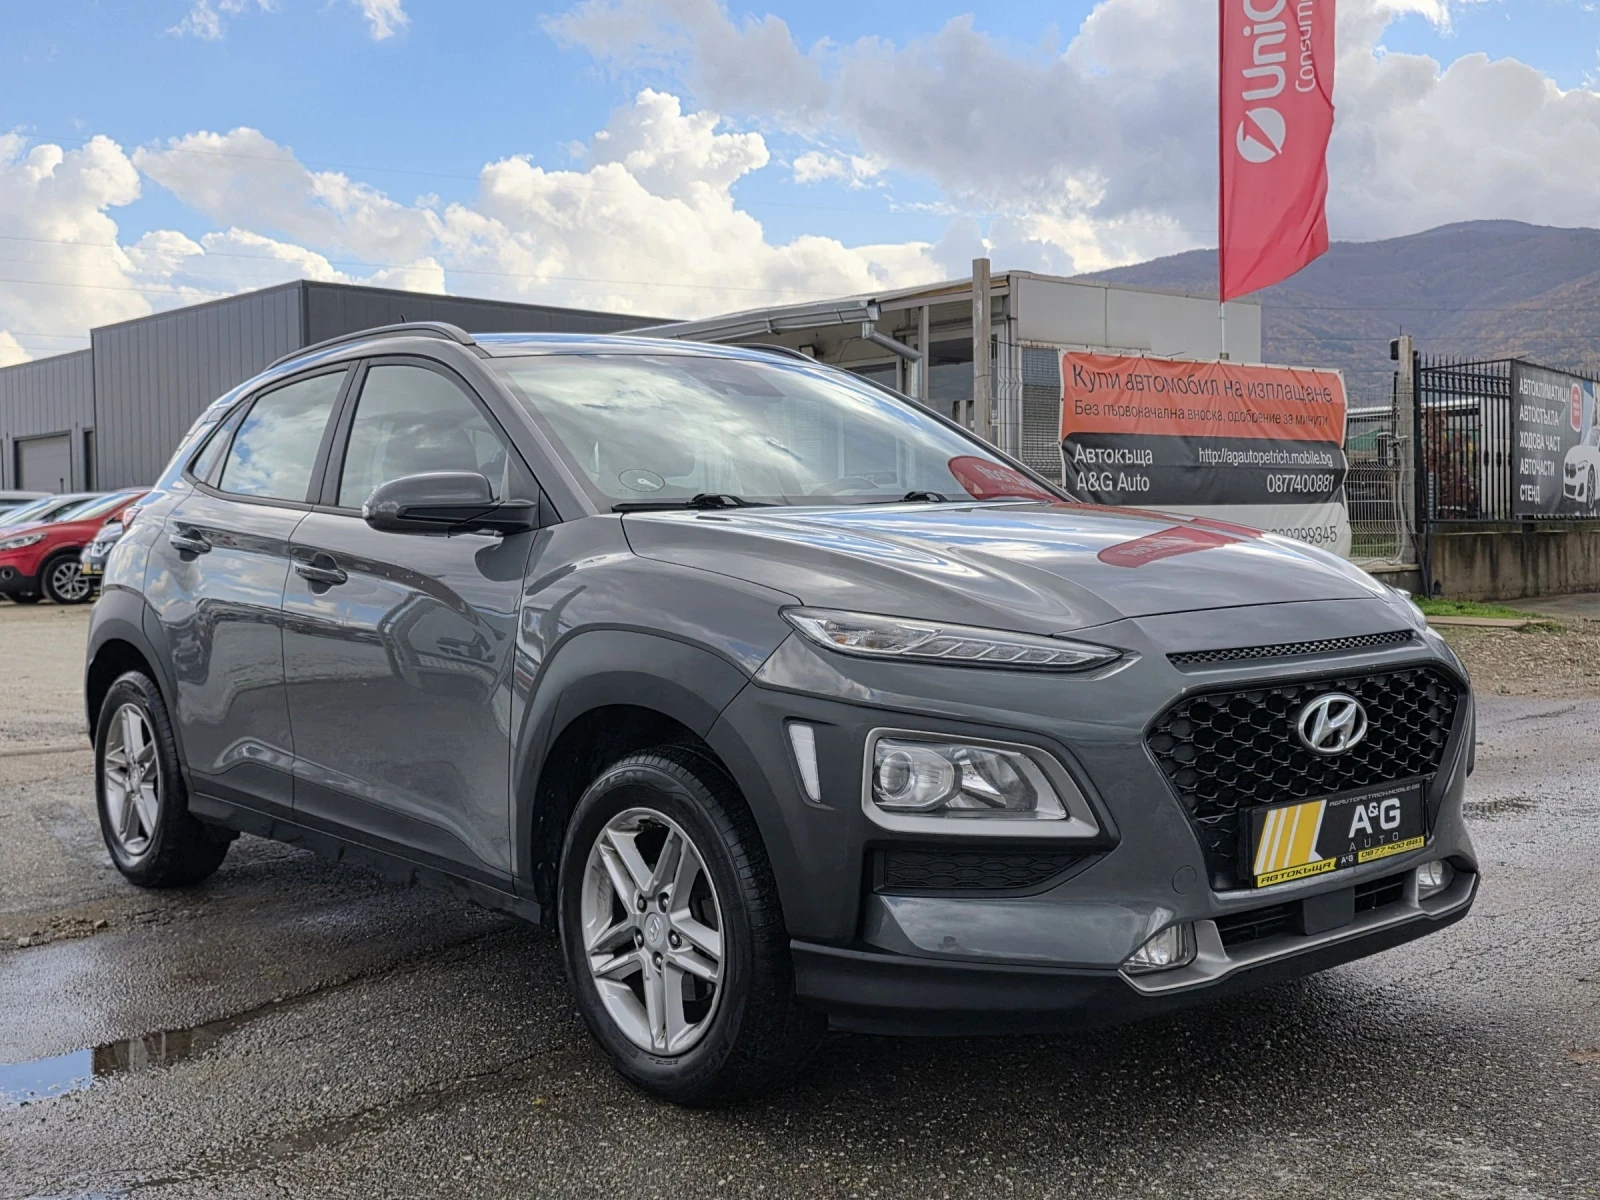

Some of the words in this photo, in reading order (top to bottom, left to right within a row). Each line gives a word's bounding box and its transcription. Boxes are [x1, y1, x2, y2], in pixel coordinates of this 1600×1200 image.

[1295, 0, 1316, 92] Consum
[1073, 363, 1121, 393] Купи
[1125, 373, 1220, 396] автомобил
[1224, 380, 1242, 397] на
[1247, 381, 1333, 405] изплащане
[1075, 400, 1099, 416] Без
[1103, 404, 1185, 420] първоначална
[1187, 408, 1226, 423] вноска,
[1228, 409, 1280, 426] одобрение
[1284, 414, 1294, 425] за
[1296, 415, 1328, 428] минути
[1519, 404, 1560, 427] АВТОСТЪКЛА
[1546, 436, 1561, 452] ЧАСТ
[1074, 444, 1153, 467] Автокъща
[1199, 448, 1333, 467] http://agautopetrich.mobile.bg
[1520, 458, 1555, 476] АВТОЧАСТИ
[1077, 472, 1112, 491] A&G
[1117, 472, 1150, 491] Auto
[1267, 474, 1334, 493] 0877400881
[1520, 484, 1540, 504] СТЕНД
[1348, 798, 1400, 838] A&G
[1349, 832, 1399, 852] AUTO
[1361, 846, 1386, 858] 0877
